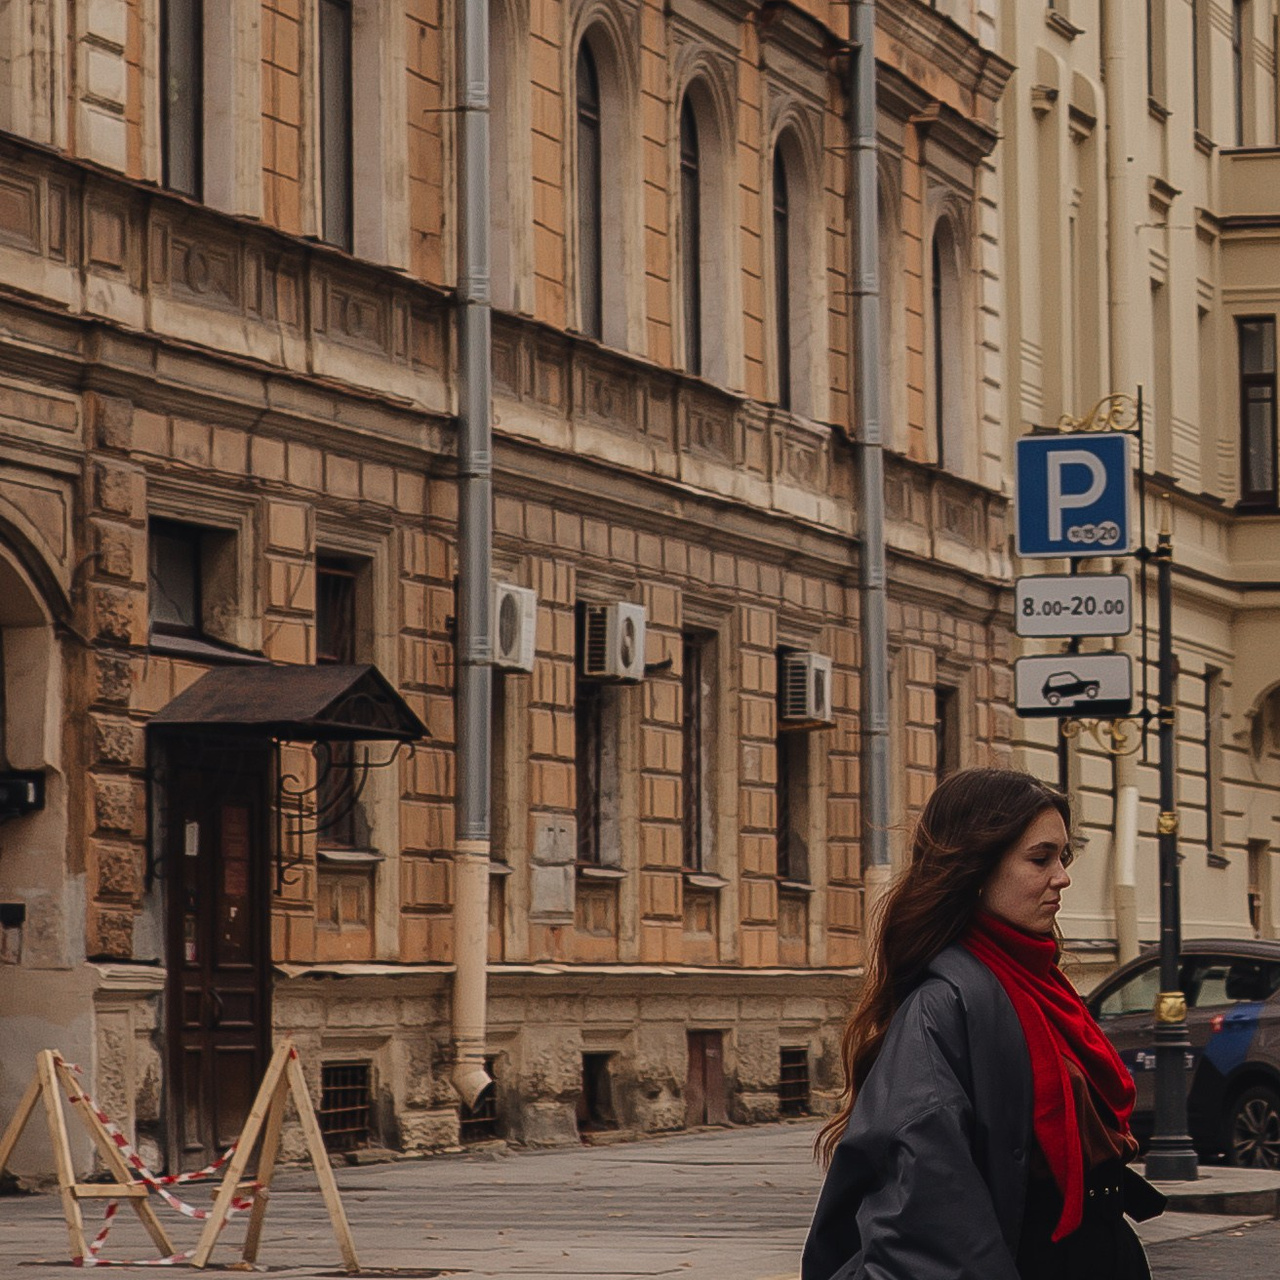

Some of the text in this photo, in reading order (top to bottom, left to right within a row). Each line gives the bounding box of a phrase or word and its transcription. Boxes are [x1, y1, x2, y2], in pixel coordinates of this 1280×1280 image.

[1046, 449, 1107, 542] P
[1100, 526, 1118, 540] 20
[1022, 595, 1124, 617] 8.00-20.00
